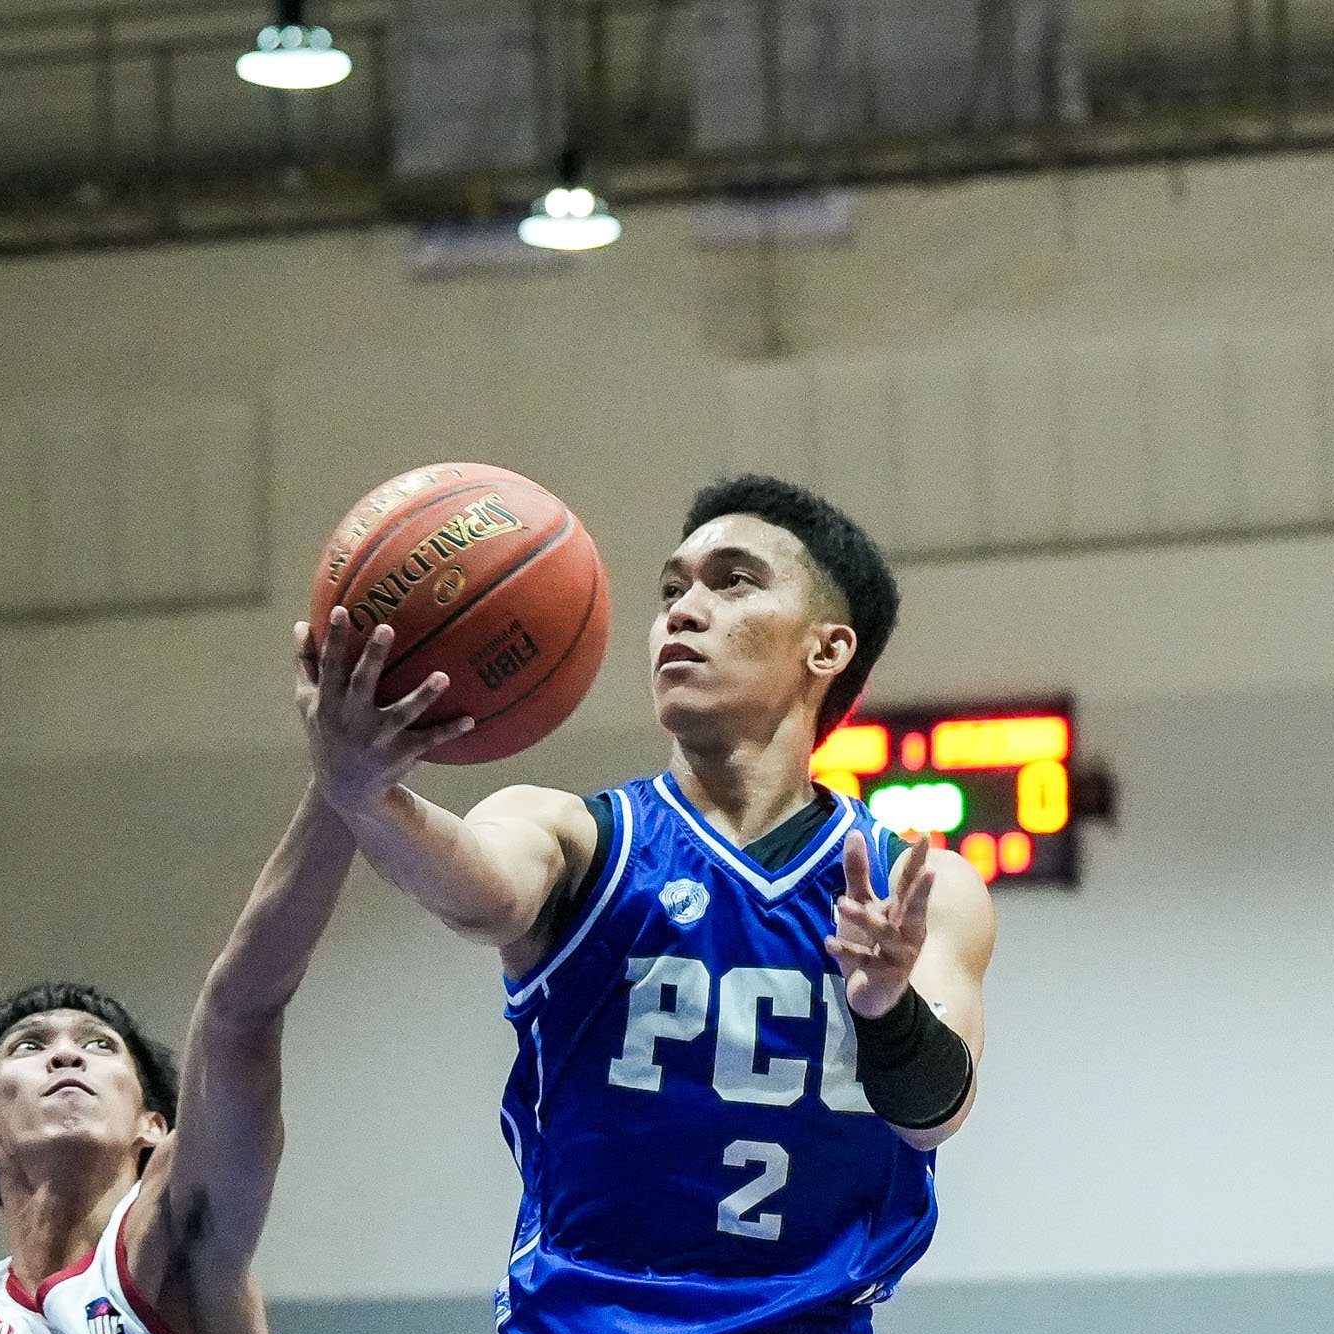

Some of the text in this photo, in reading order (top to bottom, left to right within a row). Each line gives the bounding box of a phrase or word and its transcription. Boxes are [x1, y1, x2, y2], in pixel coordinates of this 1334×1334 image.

[348, 493, 524, 636] SPALDING
[476, 633, 542, 690] FIBA
[717, 1139, 789, 1241] 2
